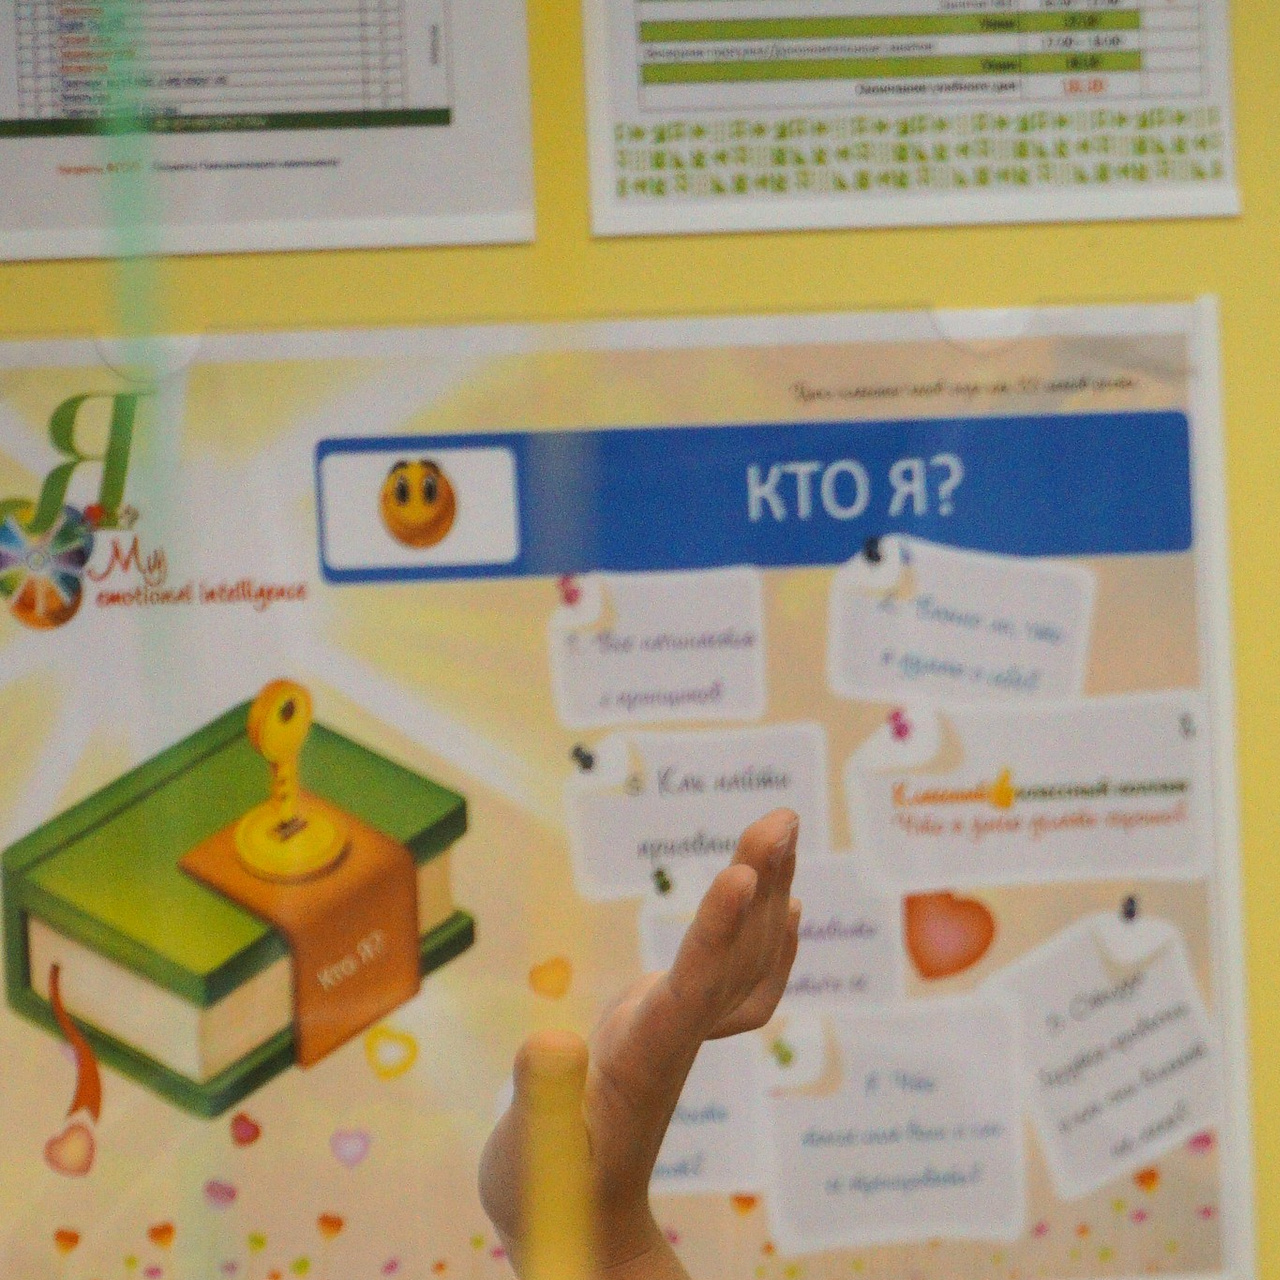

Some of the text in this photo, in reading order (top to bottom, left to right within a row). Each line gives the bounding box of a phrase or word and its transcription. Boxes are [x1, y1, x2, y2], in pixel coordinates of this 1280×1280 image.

[746, 452, 965, 523] КТО Я?
[86, 535, 168, 588] My
[97, 578, 306, 612] emotional intelligence
